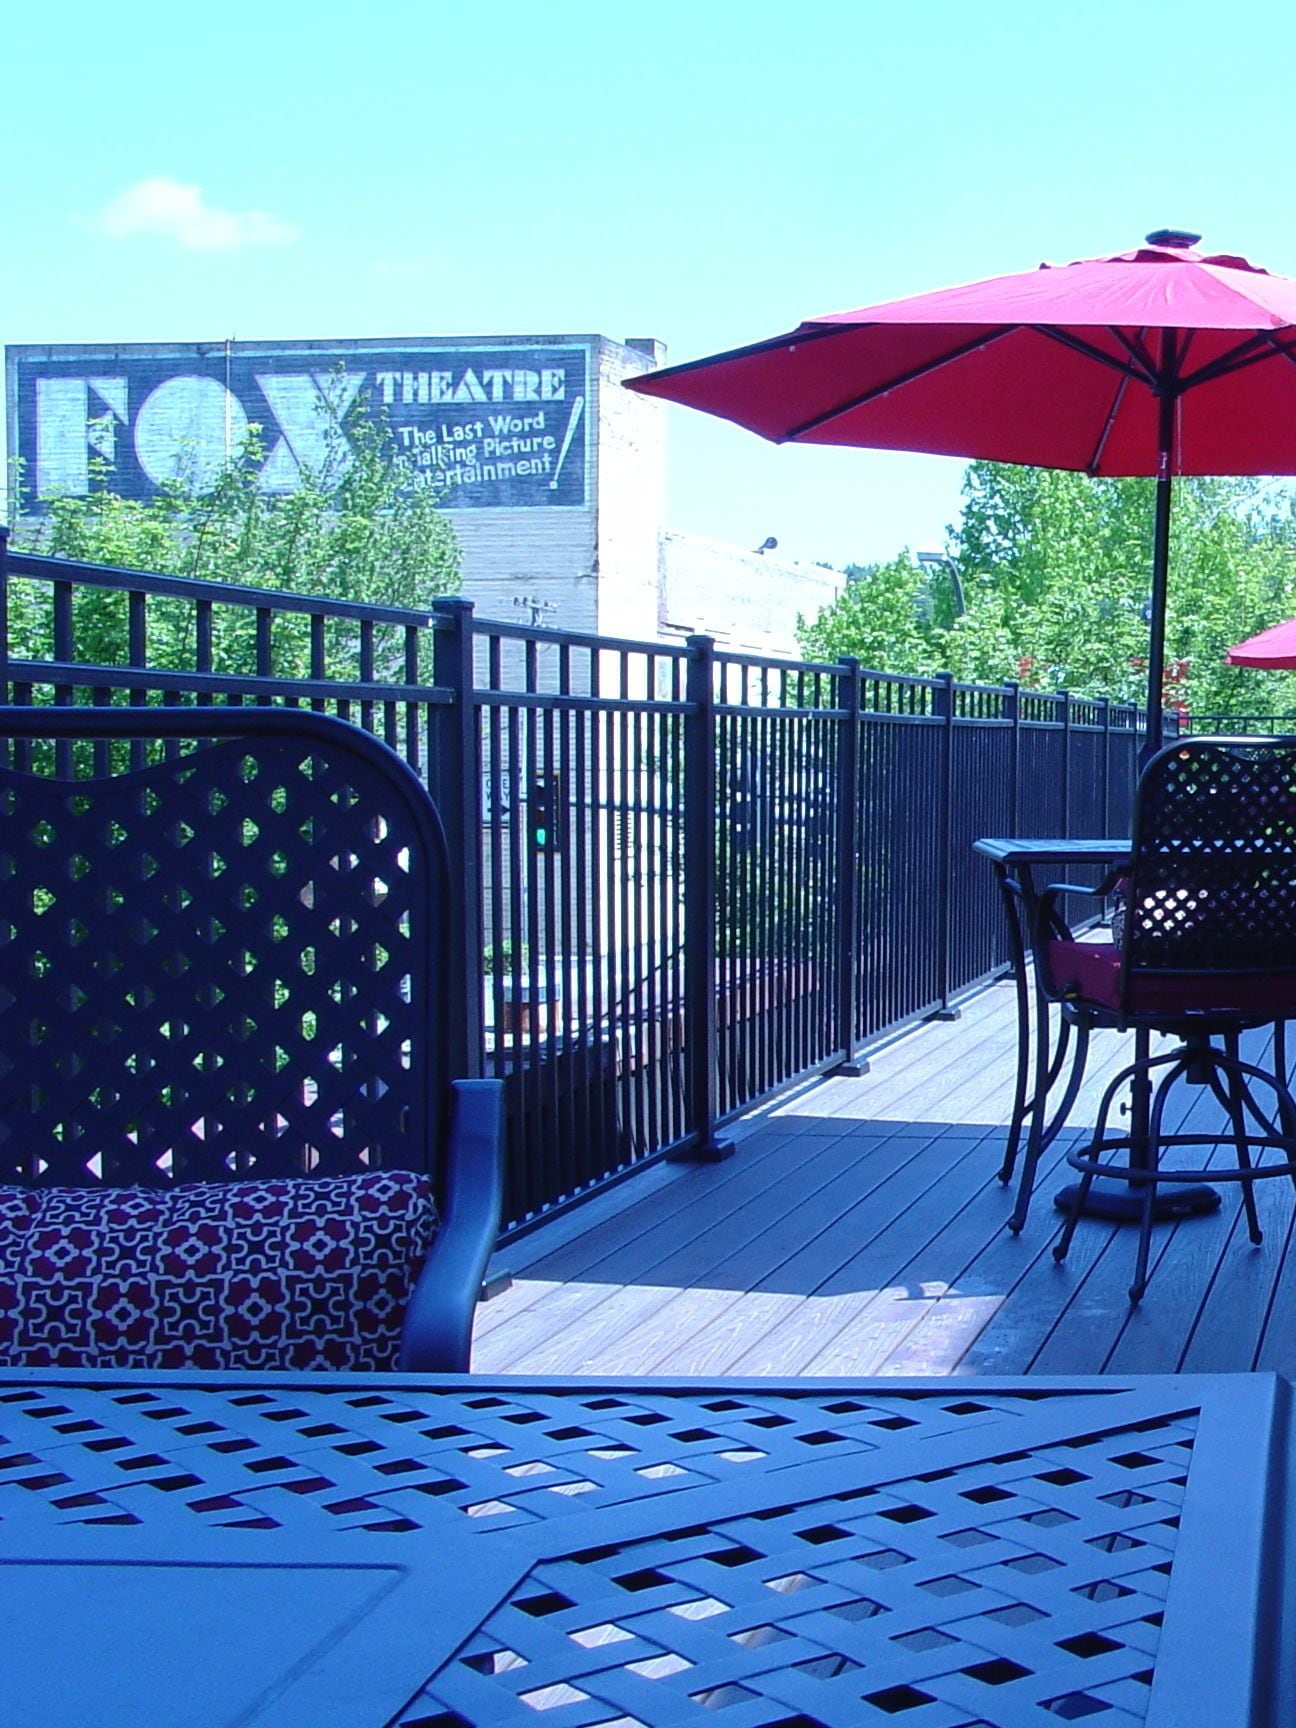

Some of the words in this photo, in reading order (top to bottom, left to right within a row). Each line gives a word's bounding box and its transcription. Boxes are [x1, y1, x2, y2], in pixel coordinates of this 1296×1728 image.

[376, 368, 565, 403] THEATRE
[36, 373, 367, 498] FOX
[398, 427, 436, 446] The
[441, 421, 484, 442] Last
[488, 411, 545, 436] Word
[483, 436, 556, 458] Picture
[486, 778, 509, 789] OE
